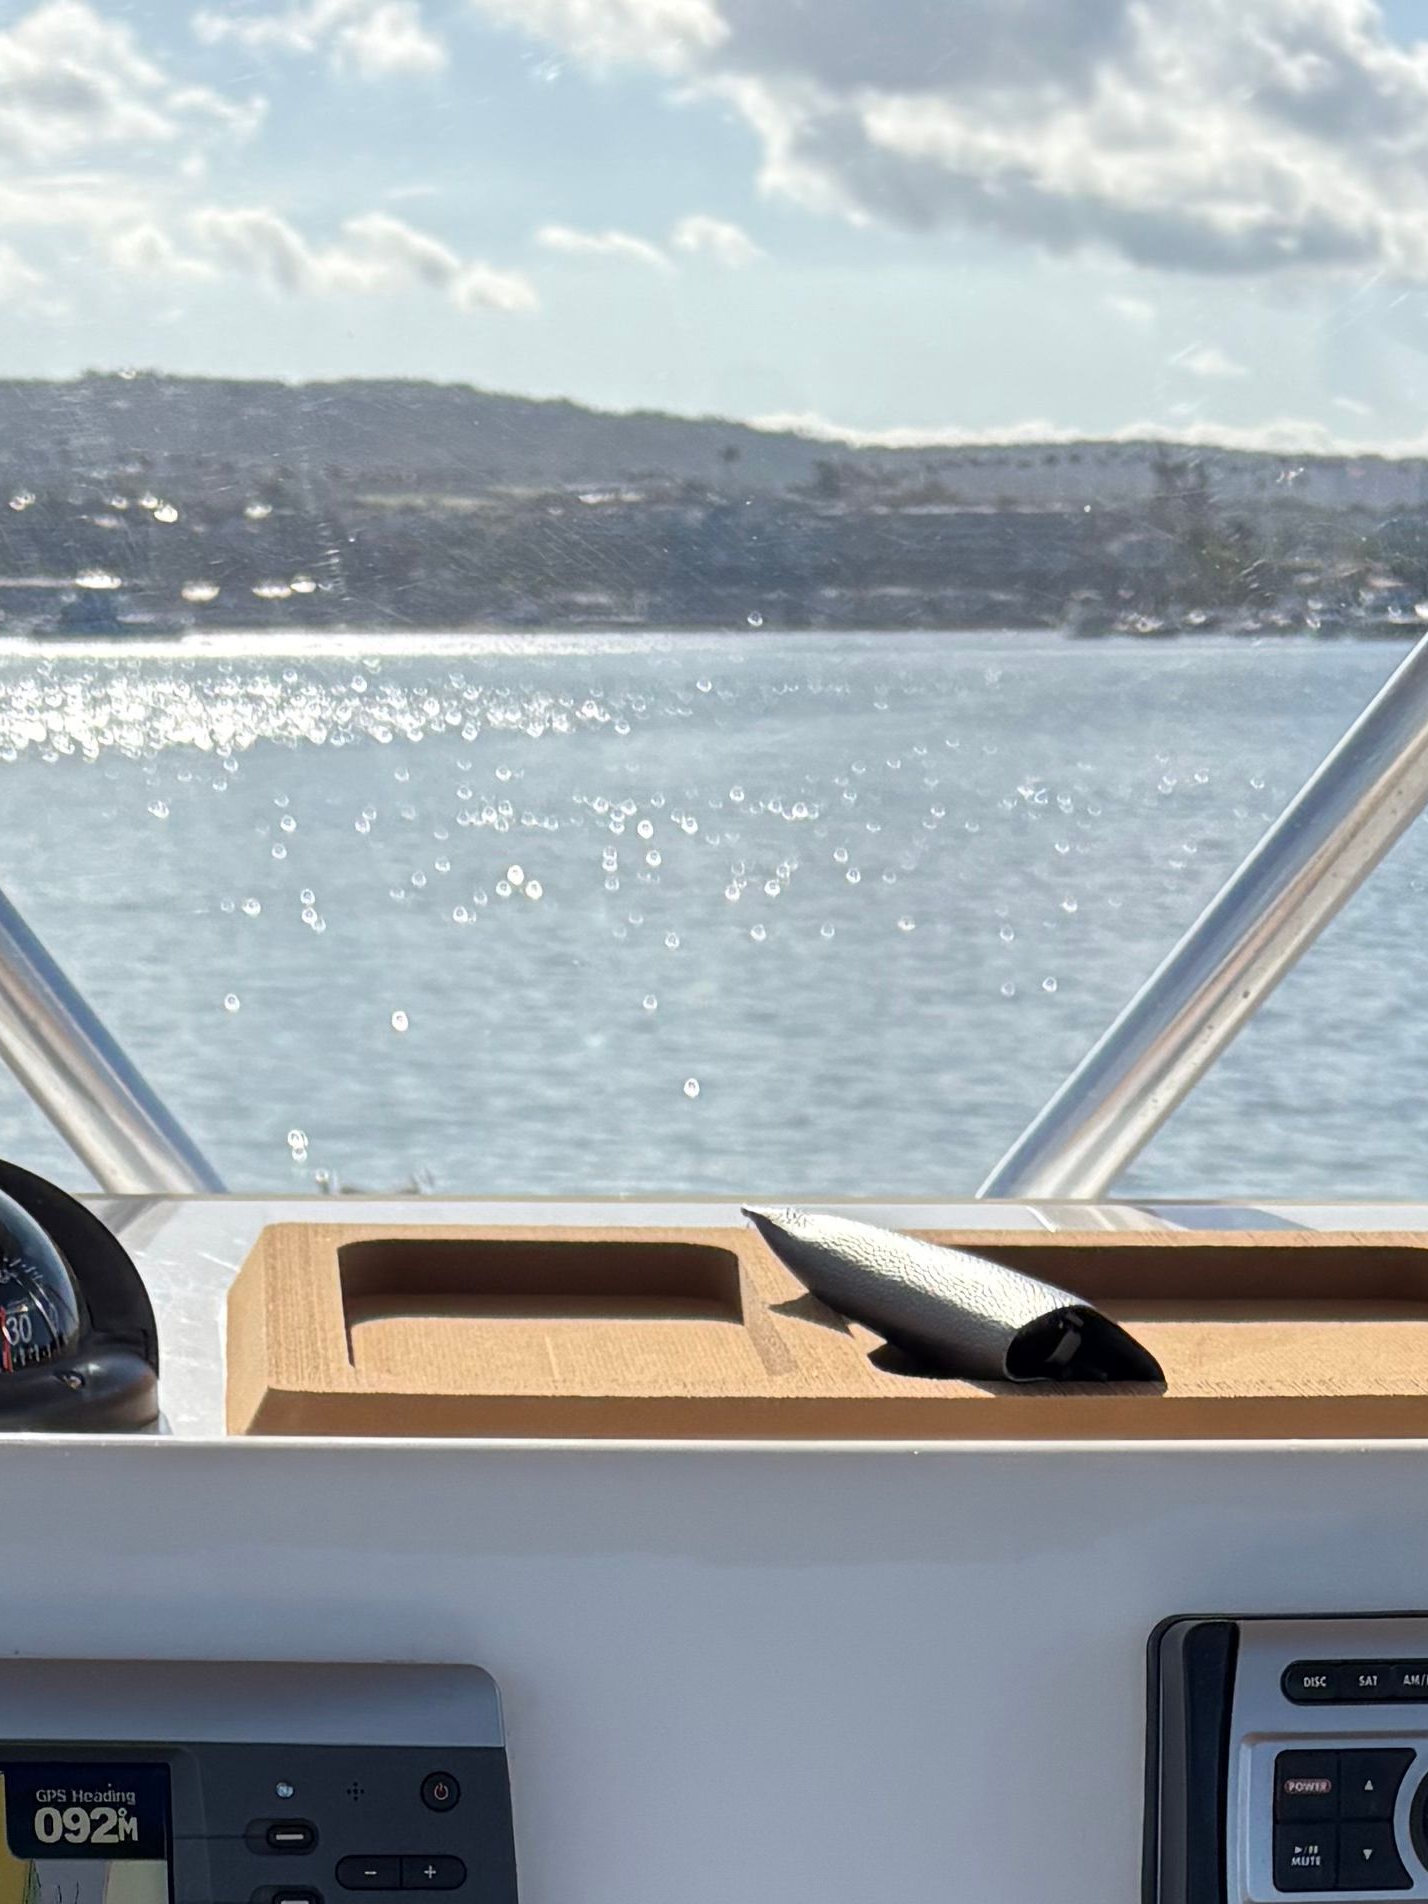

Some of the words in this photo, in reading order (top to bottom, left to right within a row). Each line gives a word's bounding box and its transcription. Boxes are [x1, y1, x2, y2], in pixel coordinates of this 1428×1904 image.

[6, 1314, 33, 1345] 30
[1303, 1675, 1327, 1688] DISC
[1358, 1674, 1378, 1687] SAT
[35, 1789, 67, 1803] GPS
[71, 1789, 136, 1806] Heading
